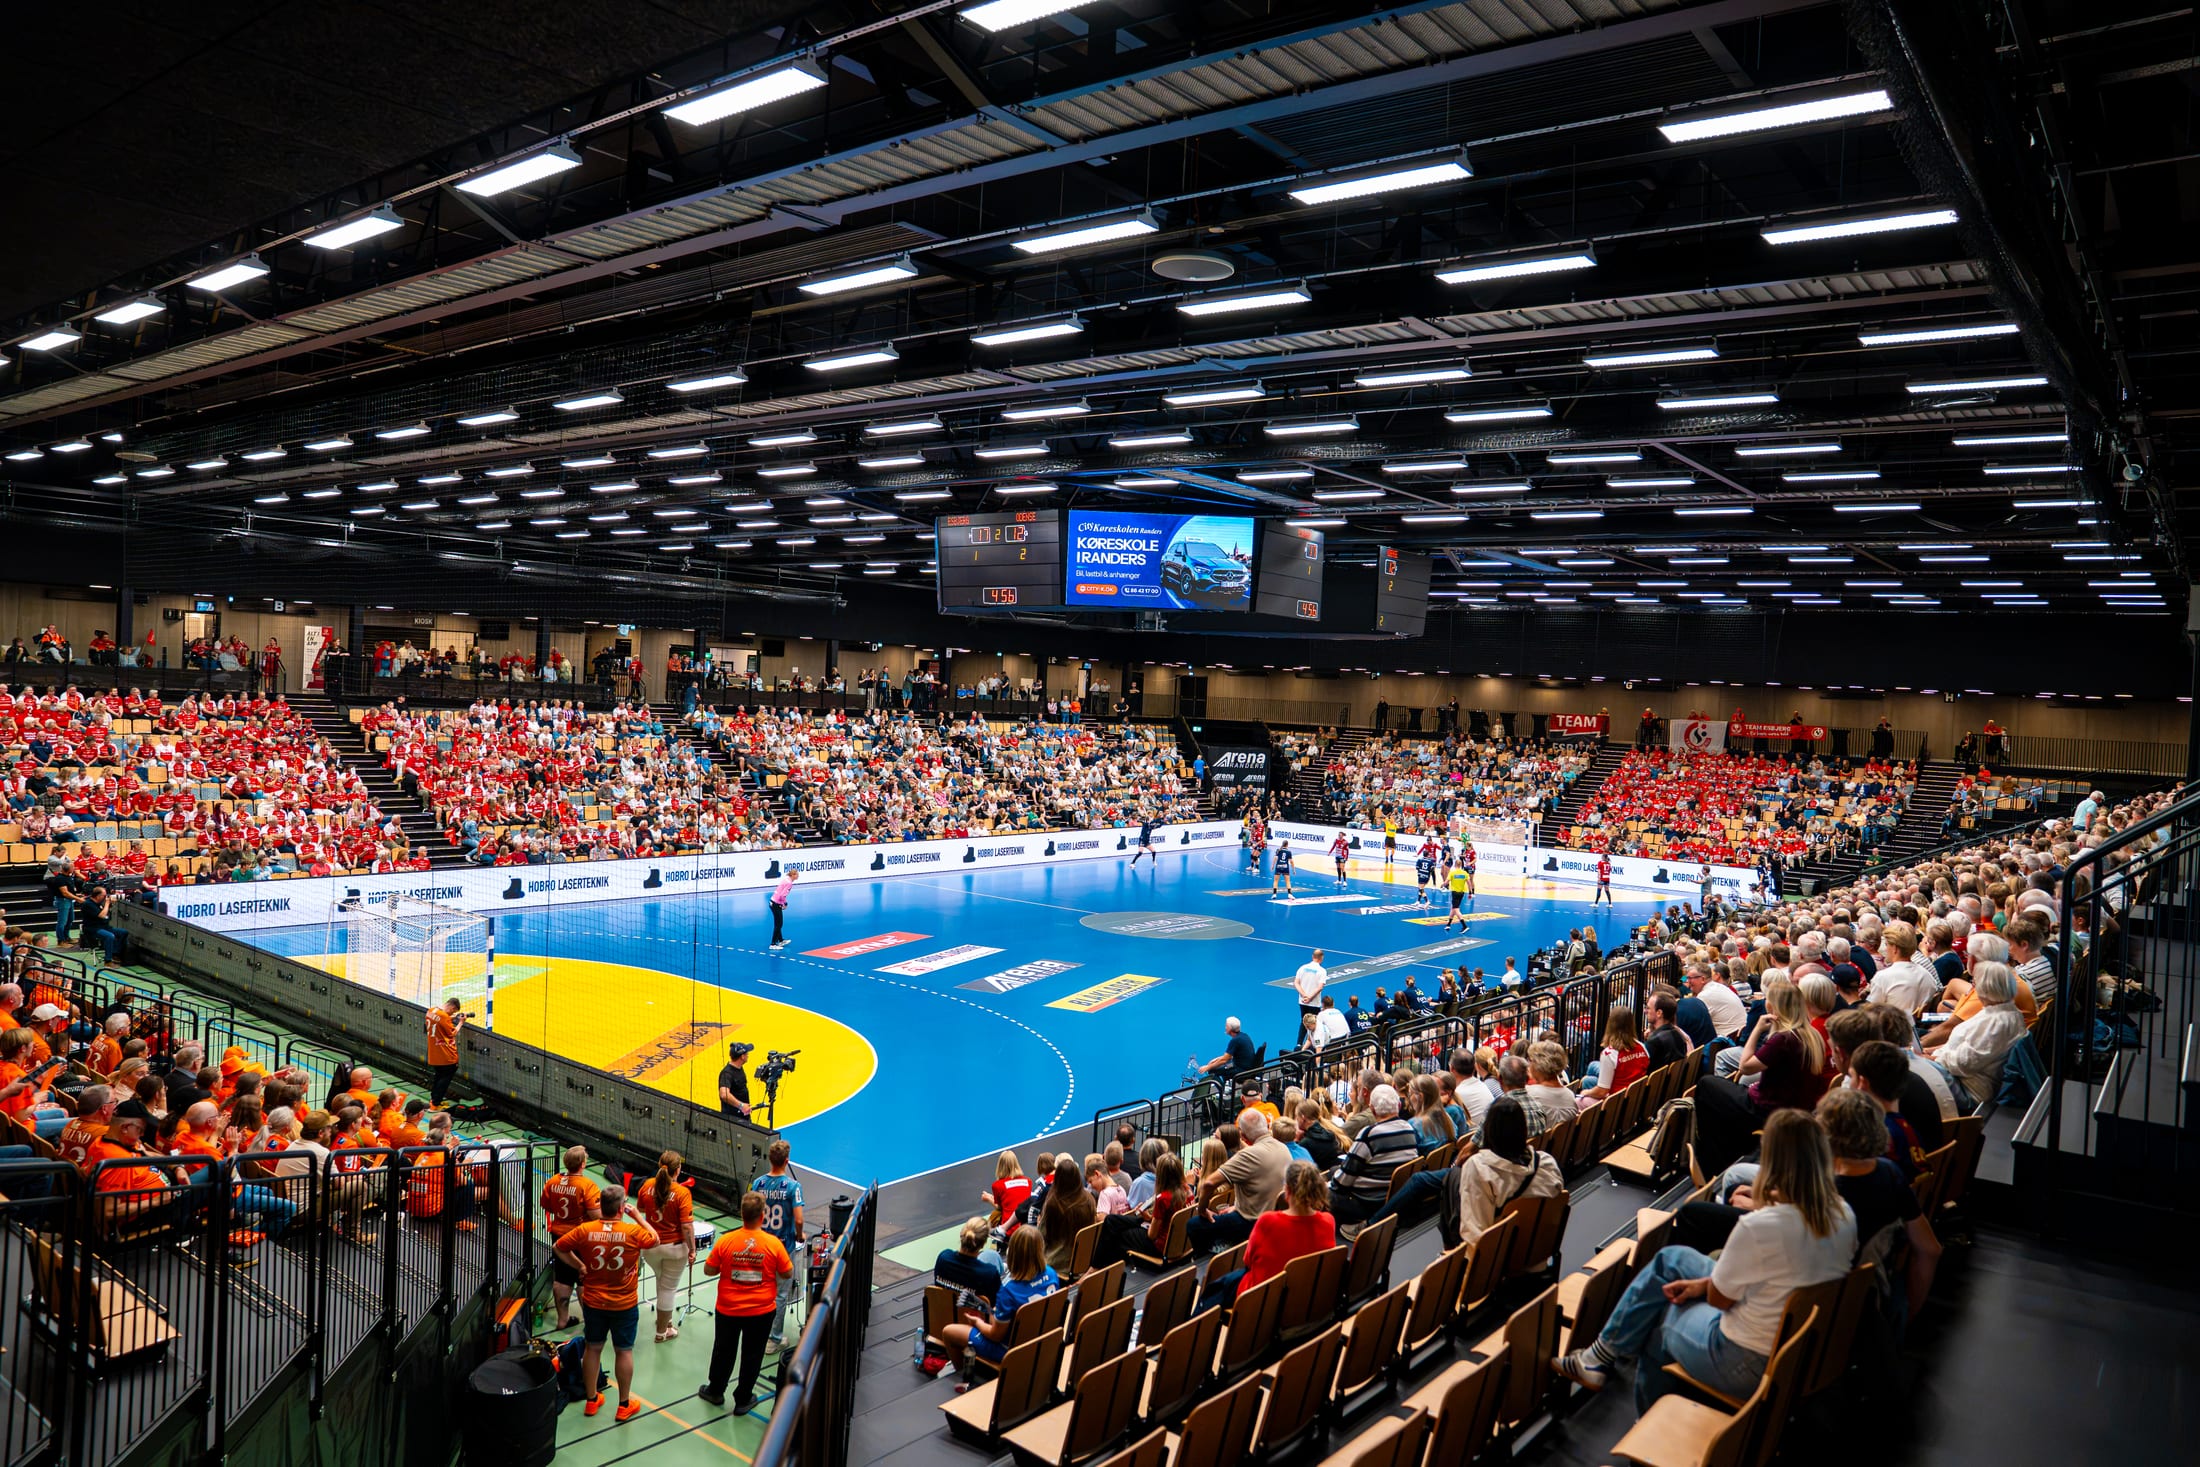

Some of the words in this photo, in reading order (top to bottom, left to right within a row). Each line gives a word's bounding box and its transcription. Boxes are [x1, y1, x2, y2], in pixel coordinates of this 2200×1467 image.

[979, 528, 989, 541] 17
[994, 528, 1000, 540] 2
[1013, 526, 1024, 540] 12
[1077, 537, 1159, 552] KØRESKOLE
[1020, 548, 1026, 560] 2
[1076, 552, 1080, 563] I
[1082, 552, 1146, 566] RANDERS
[274, 601, 284, 611] B
[414, 617, 433, 625] KIOSK
[872, 643, 878, 651] D
[1626, 682, 1632, 690] G
[1945, 692, 1954, 702] H
[1556, 715, 1597, 728] TEAM
[1212, 752, 1266, 768] Arena
[1275, 830, 1291, 839] HOBRO
[1292, 832, 1325, 842] LASERTEKNIK
[1057, 842, 1072, 851] HOBRO
[1072, 840, 1099, 850] LASERTEKNIK
[1363, 840, 1381, 849] HOBRO
[887, 854, 905, 865] HOBRO
[906, 852, 941, 864] LASERTEKNIK
[978, 848, 994, 858] HOBRO
[994, 846, 1025, 856] LASERTEKNIK
[806, 859, 845, 872] LASERTEKNIK
[1561, 861, 1582, 870] HOBRO
[1583, 862, 1624, 875] LASEKNIK
[666, 870, 689, 882] HOBRO
[691, 866, 736, 880] LASERTEKNIK
[528, 880, 555, 892] HOBRO
[558, 876, 609, 890] LASERTEKNIK
[177, 902, 216, 918] HOBRO
[220, 898, 291, 915] LASERTEKNIK
[769, 1190, 787, 1200] HOLTE
[557, 1197, 569, 1219] 3
[590, 1245, 625, 1271] 33
